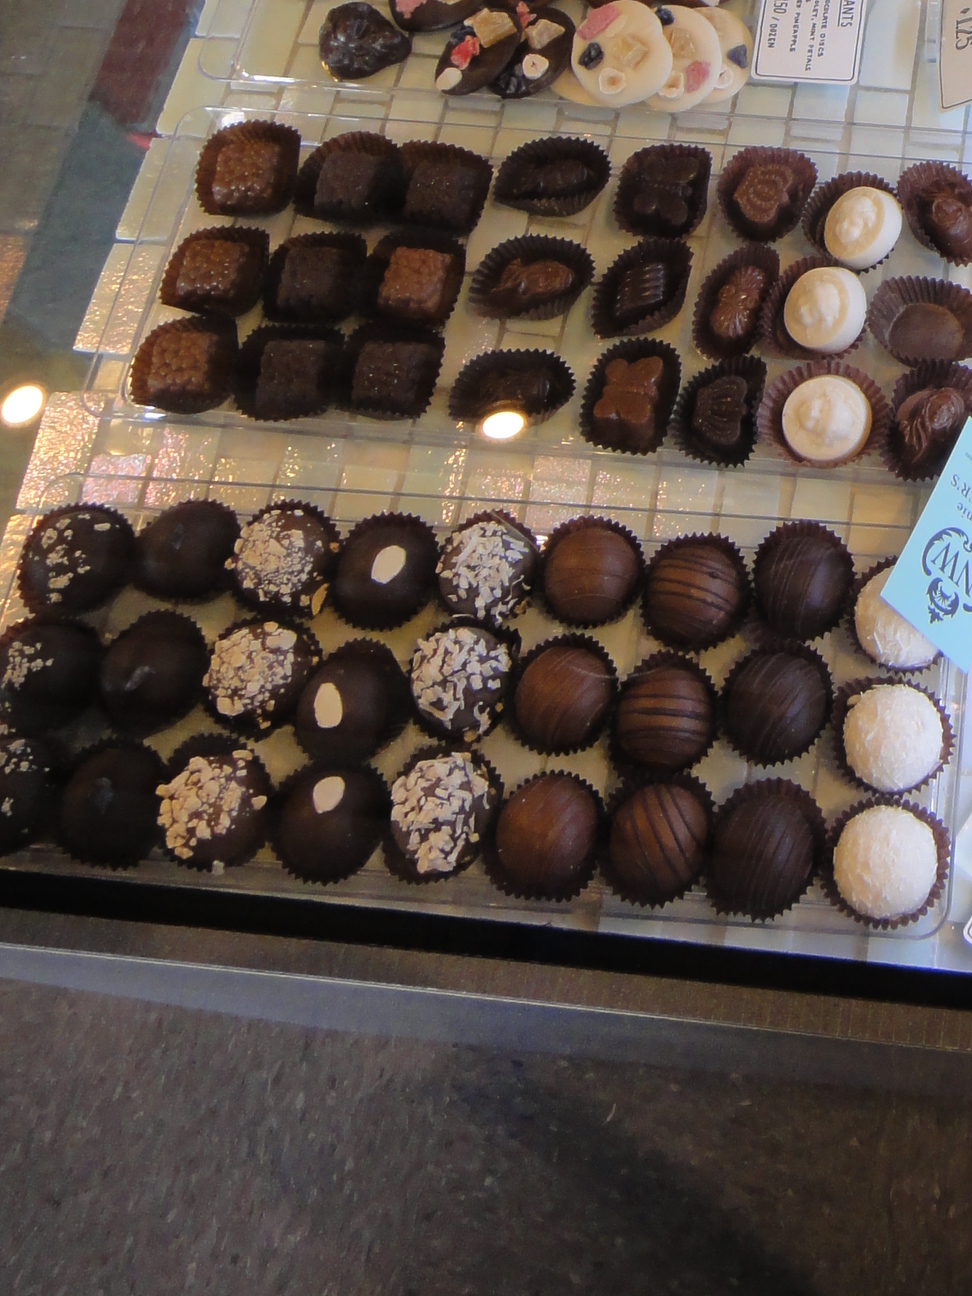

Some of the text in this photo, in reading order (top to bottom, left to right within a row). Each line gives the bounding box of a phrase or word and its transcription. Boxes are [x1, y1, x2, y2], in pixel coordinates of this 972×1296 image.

[789, 11, 800, 52] PINEAPPLE
[817, 32, 825, 57] DISCS
[804, 44, 813, 71] PETALS
